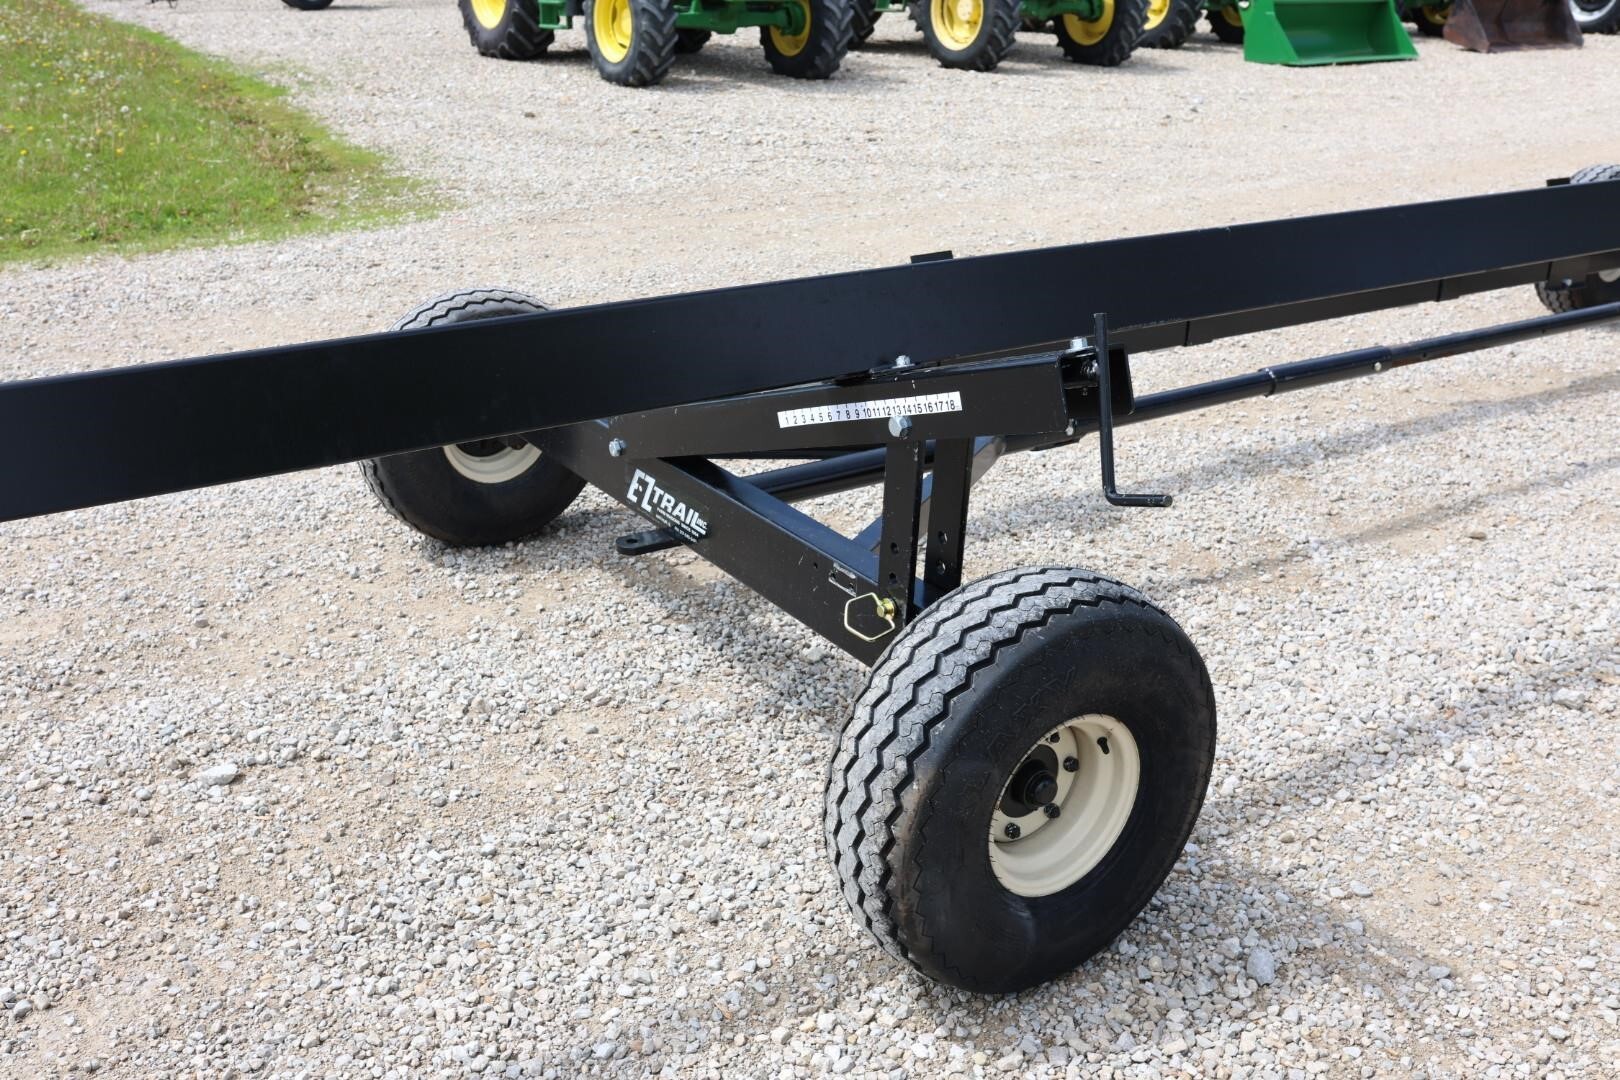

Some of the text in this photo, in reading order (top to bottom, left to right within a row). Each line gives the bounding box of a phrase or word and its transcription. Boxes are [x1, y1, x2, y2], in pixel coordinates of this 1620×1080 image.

[793, 415, 798, 424] 2
[802, 414, 806, 423] 3
[810, 413, 815, 422] 4
[819, 412, 823, 422] 5
[828, 412, 832, 421] 6
[837, 411, 841, 420] 7
[846, 410, 851, 419] 8
[855, 409, 860, 419] 9
[863, 408, 872, 418] 10
[873, 406, 880, 416] 11
[882, 406, 891, 416] 12
[893, 405, 902, 415] 13
[903, 404, 912, 414] 14
[913, 403, 922, 413] 15
[924, 402, 934, 412] 16
[934, 401, 943, 411] 17
[946, 400, 956, 410] 18
[652, 486, 706, 536] TRAIL
